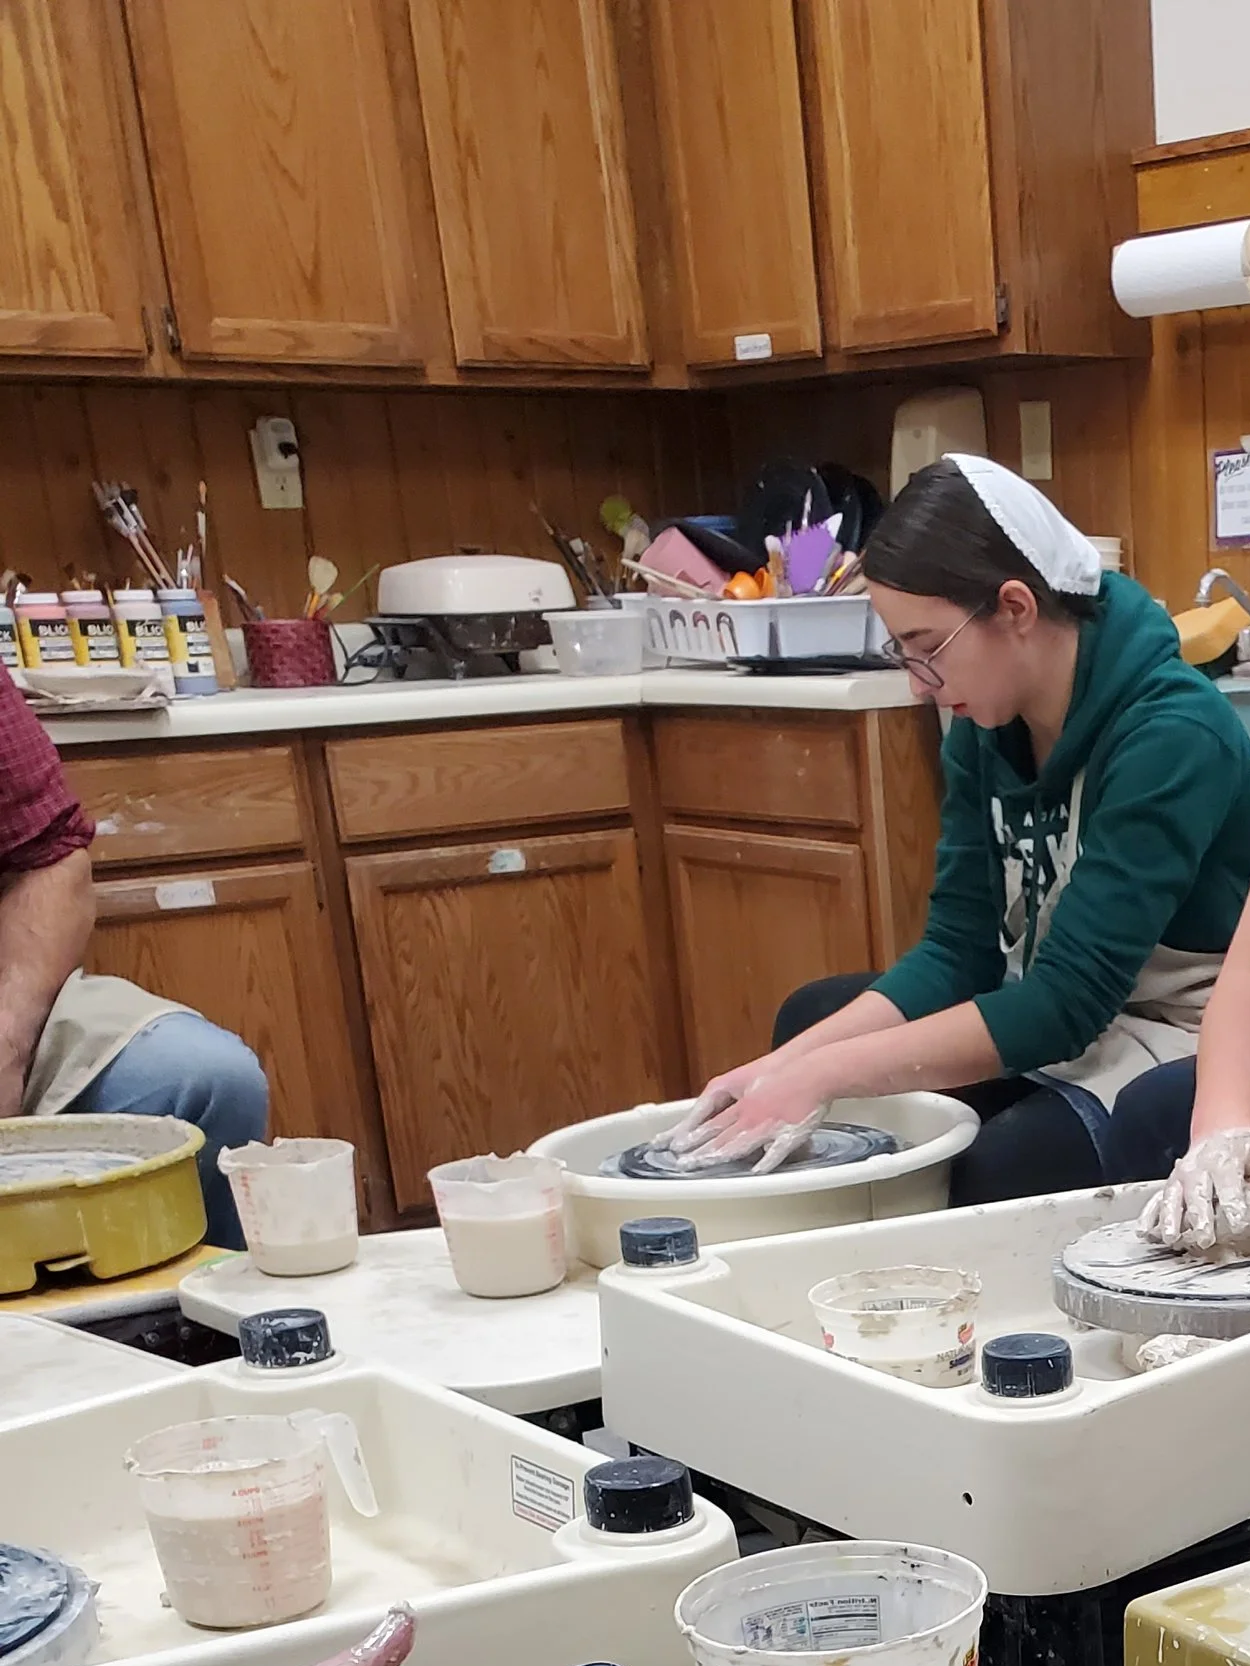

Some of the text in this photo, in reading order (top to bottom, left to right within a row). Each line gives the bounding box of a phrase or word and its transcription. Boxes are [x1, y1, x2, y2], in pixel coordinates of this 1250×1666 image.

[37, 624, 69, 638] BLIC
[86, 623, 115, 638] BLIC
[134, 622, 164, 637] BLIC
